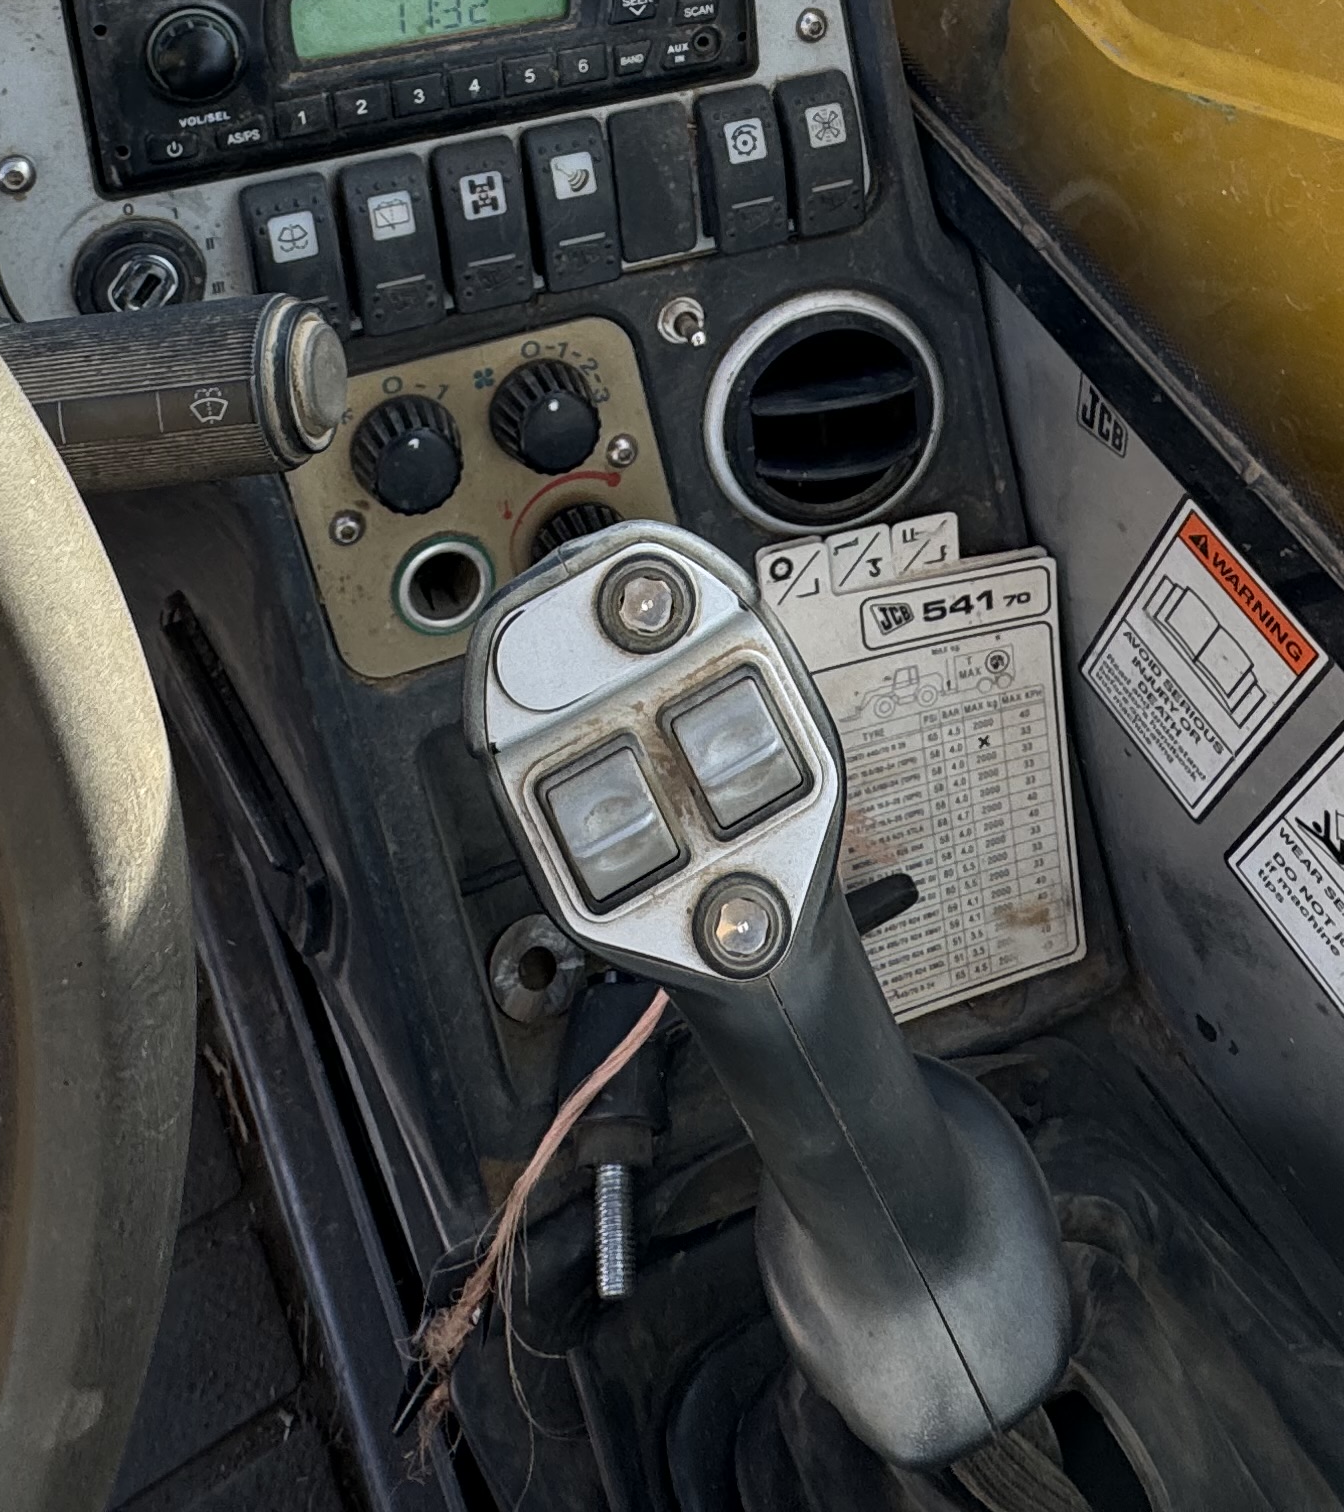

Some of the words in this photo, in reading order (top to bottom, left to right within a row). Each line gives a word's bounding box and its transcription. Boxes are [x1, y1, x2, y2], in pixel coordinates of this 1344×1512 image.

[683, 4, 714, 18] SCAN
[667, 42, 689, 55] AUX
[578, 58, 589, 74] 6
[619, 53, 645, 66] BAND
[524, 68, 536, 83] 5
[468, 78, 481, 93] 4
[413, 88, 425, 104] 3
[356, 99, 368, 115] 2
[178, 111, 231, 128] VOL/SEL
[297, 110, 306, 125] 1
[227, 129, 261, 145] AS/PS
[1081, 384, 1124, 452] JCB
[878, 603, 913, 632] JCB
[923, 590, 993, 623] 541
[1003, 592, 1031, 607] 70
[1212, 551, 1303, 663] WARNING
[959, 667, 982, 679] MAX
[1123, 631, 1162, 677] AVOID
[1163, 678, 1225, 755] SERIOUS
[1131, 656, 1179, 713] INJURY
[1179, 716, 1202, 745] OR
[1138, 680, 1183, 737] DEATH
[1279, 827, 1324, 884] WEAR
[1258, 868, 1285, 904] tips
[1272, 851, 1298, 882] DO
[1299, 885, 1337, 926] NOT
[1277, 877, 1341, 957] machine
